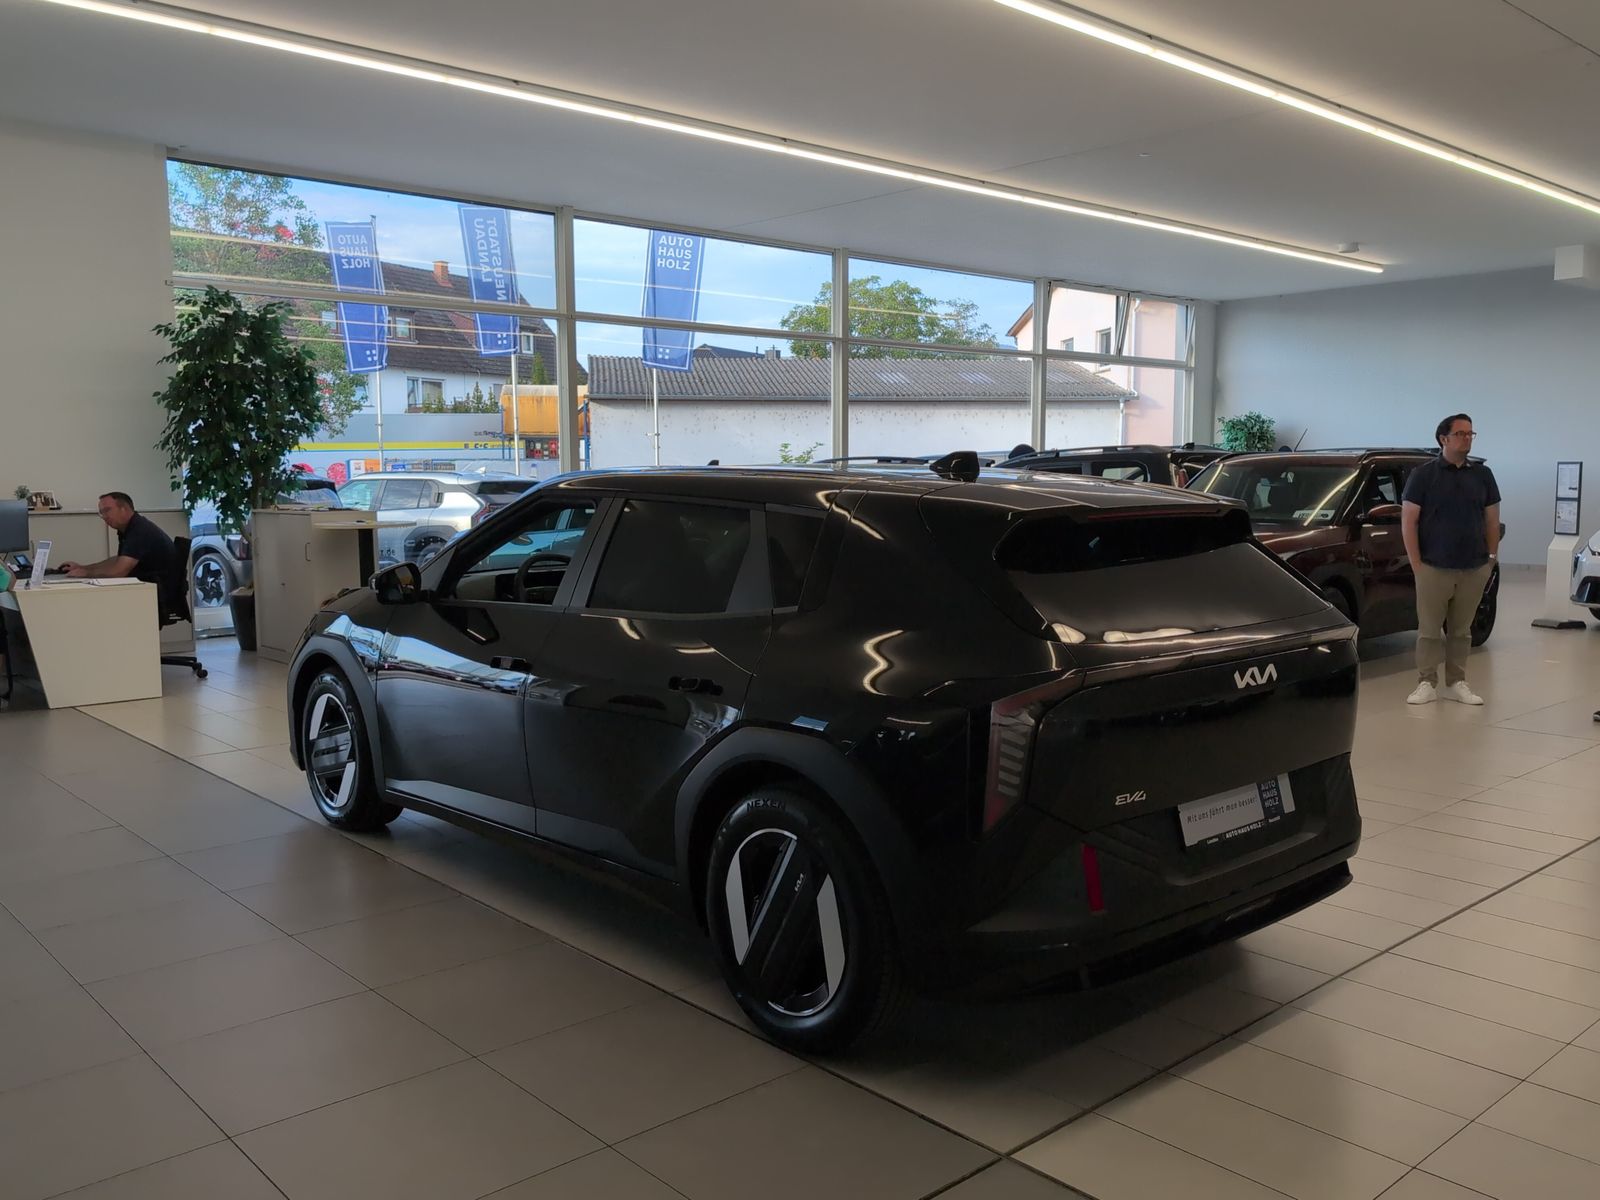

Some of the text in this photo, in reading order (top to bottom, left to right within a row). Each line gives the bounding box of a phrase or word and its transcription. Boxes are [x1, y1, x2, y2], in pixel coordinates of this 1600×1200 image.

[659, 235, 693, 248] AUTO
[658, 246, 692, 259] HAUS
[656, 258, 691, 271] HOLZ
[1233, 663, 1278, 689] KIA
[1261, 779, 1276, 790] AUTO
[1115, 790, 1146, 805] EV4
[1262, 788, 1278, 799] HAUS
[746, 798, 786, 812] NEXEN
[1264, 797, 1280, 808] HOLZ
